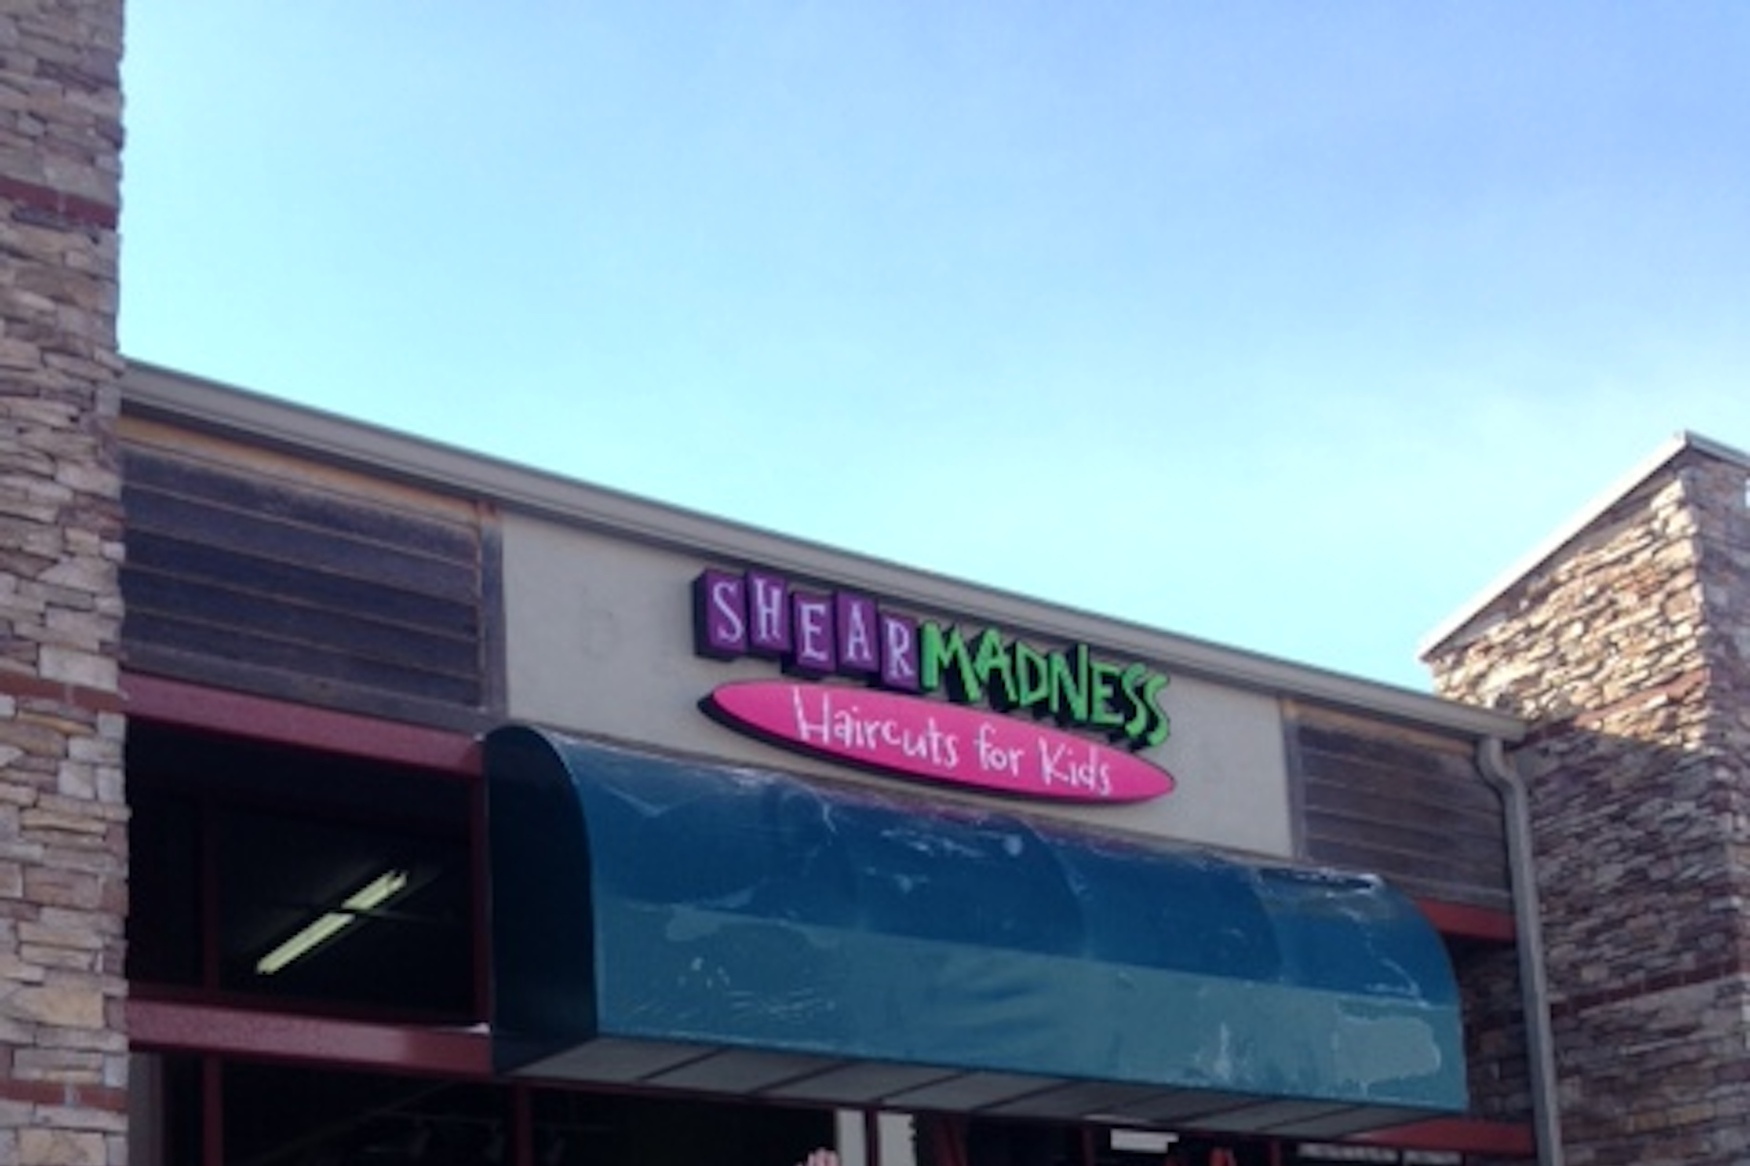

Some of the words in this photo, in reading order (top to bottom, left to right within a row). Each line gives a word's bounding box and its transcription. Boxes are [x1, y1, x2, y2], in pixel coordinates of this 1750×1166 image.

[711, 575, 916, 683] SHEAR
[920, 621, 1171, 747] MADNESS
[792, 686, 960, 770] Haircuts
[974, 722, 1025, 778] for
[1038, 737, 1111, 797] Kids
